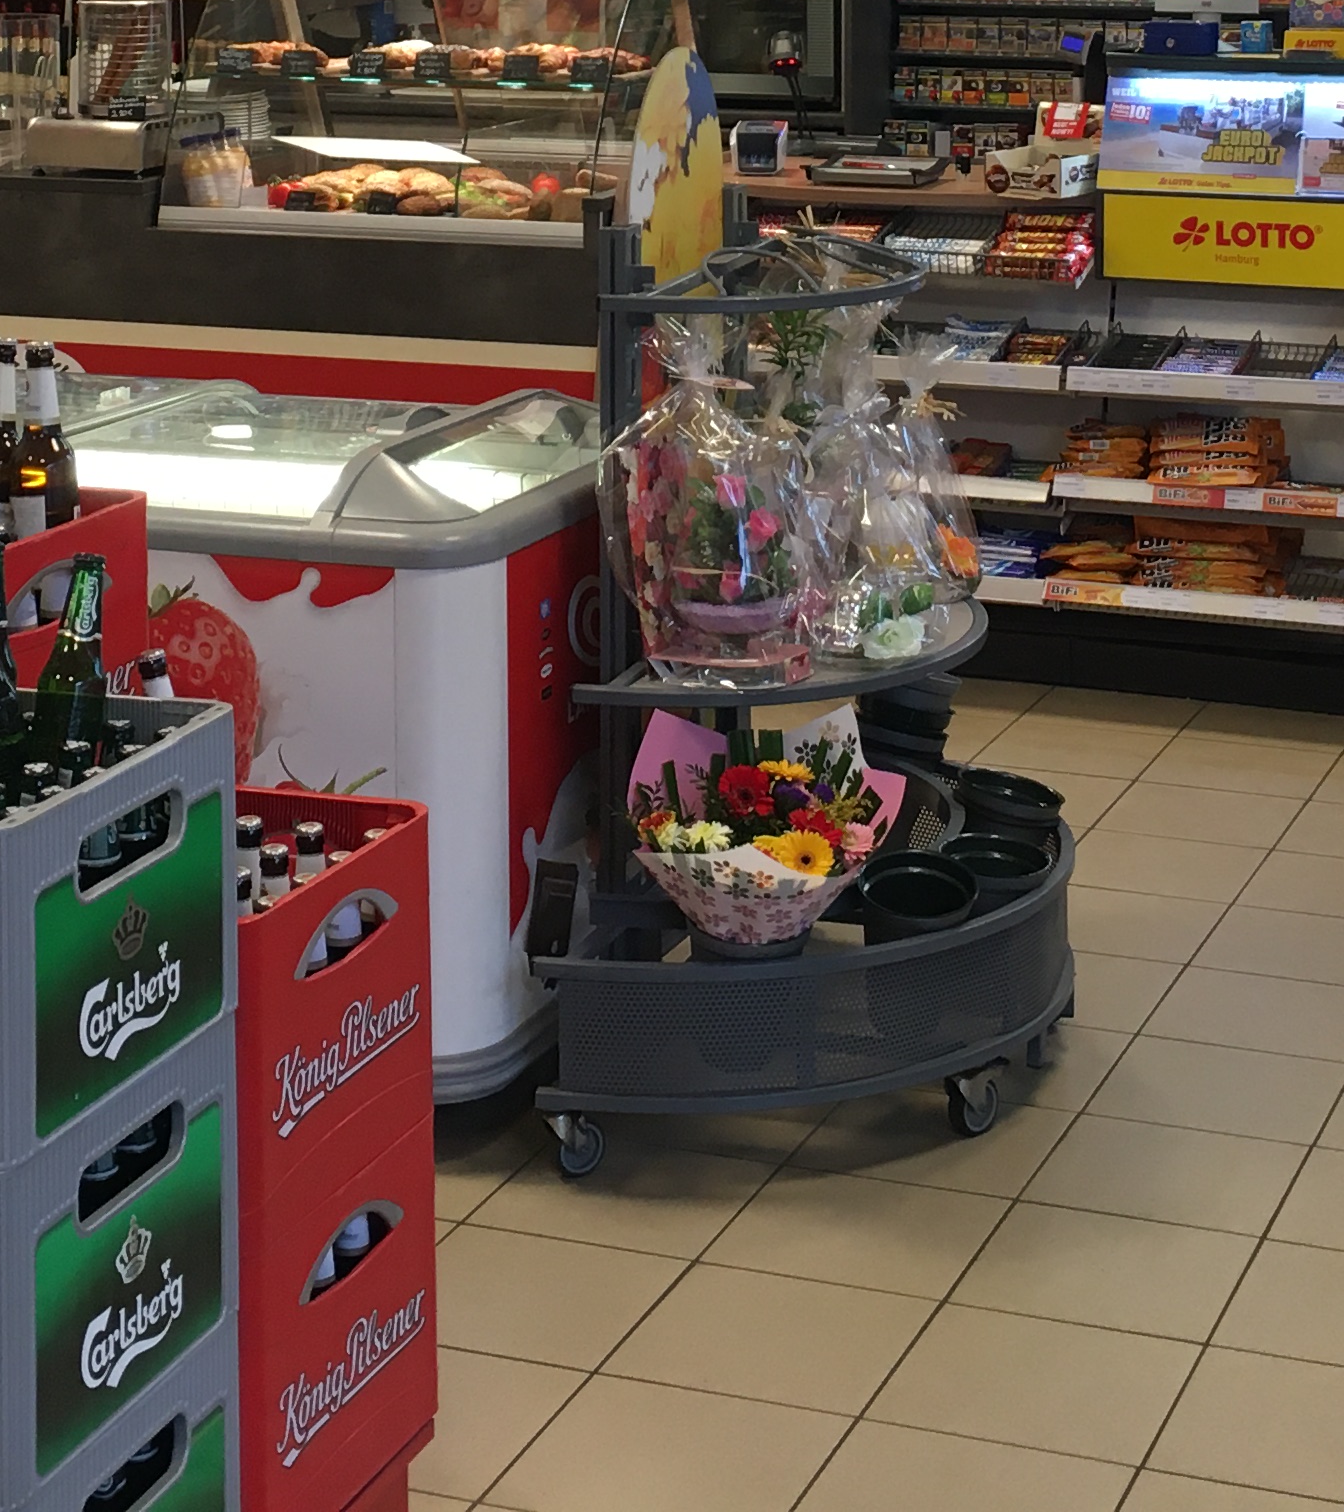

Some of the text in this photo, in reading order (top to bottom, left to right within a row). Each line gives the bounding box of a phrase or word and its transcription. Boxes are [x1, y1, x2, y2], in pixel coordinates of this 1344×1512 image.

[1202, 145, 1281, 165] JACKPOT
[1219, 130, 1272, 146] EURO
[1216, 220, 1316, 250] LOTTO
[80, 958, 180, 1061] Carlsberg
[273, 985, 420, 1122] König Pilsener
[81, 1277, 184, 1388] Carlsberg
[277, 1290, 425, 1455] König Pilsener
